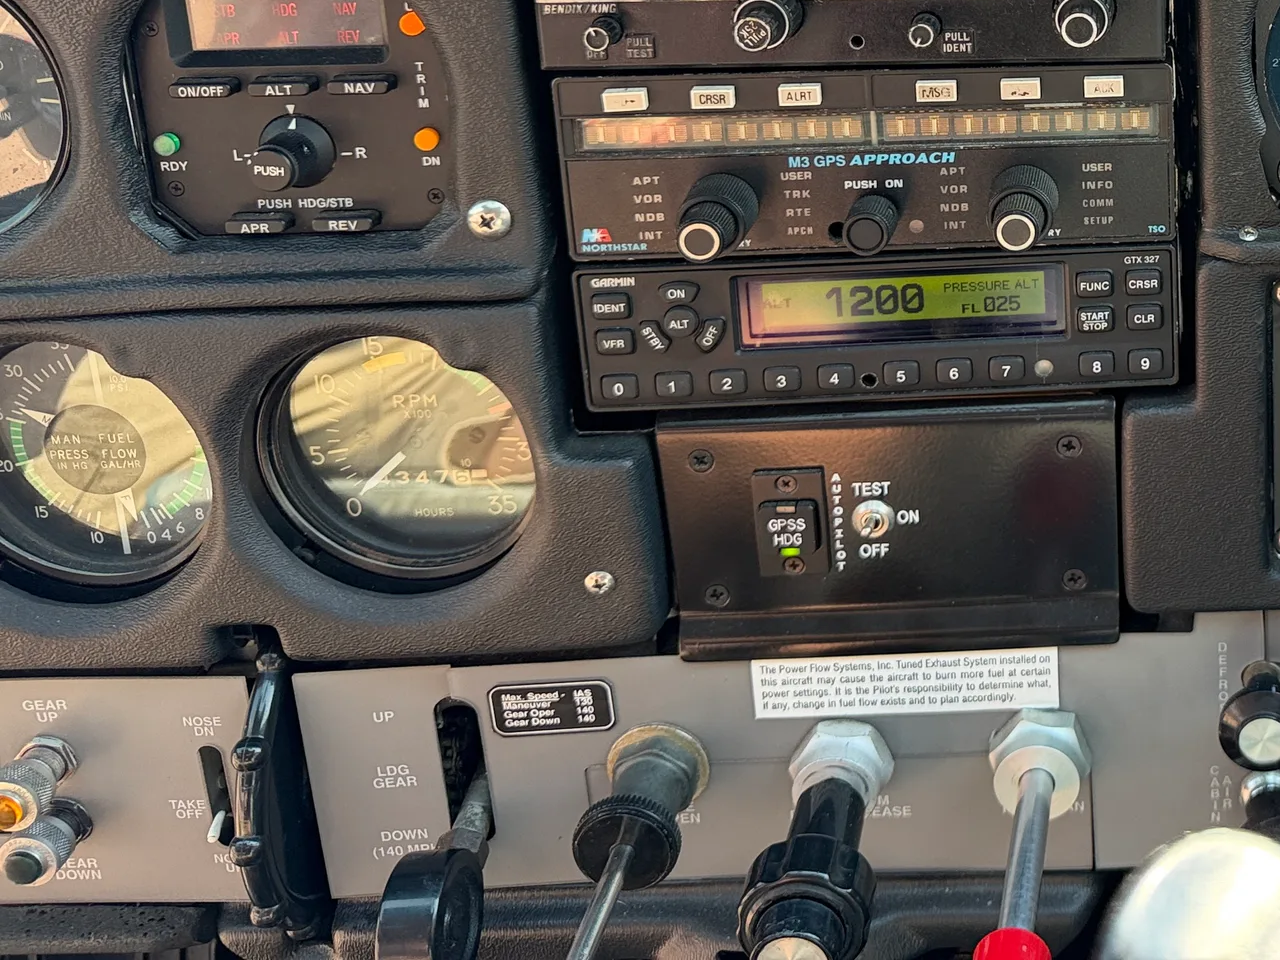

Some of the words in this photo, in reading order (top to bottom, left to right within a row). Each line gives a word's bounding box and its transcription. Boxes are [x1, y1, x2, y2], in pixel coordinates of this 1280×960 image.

[544, 4, 616, 14] BENDIX/KING
[943, 43, 972, 52] IDENT
[178, 87, 223, 97] ON/OFF
[787, 91, 812, 101] ALRT
[789, 157, 809, 167] M3
[814, 156, 845, 167] GPS
[850, 152, 956, 166] APPROACH
[160, 161, 187, 171] RDY
[781, 172, 811, 180] USER
[1082, 181, 1112, 189] INFO
[258, 199, 292, 208] PUSH
[299, 198, 353, 207] HDG/STB
[635, 213, 664, 221] NDB
[1084, 217, 1113, 225] SETUP
[240, 223, 269, 233] APR
[788, 226, 813, 235] APCH
[582, 243, 647, 252] NORTHSTAR
[1124, 256, 1142, 264] GTX
[590, 277, 635, 288] GARMIN
[944, 280, 1009, 292] PRESSURE
[1016, 279, 1038, 289] ALT
[1080, 281, 1109, 292] FUNC
[826, 284, 924, 317] 1200
[594, 304, 625, 313] IDENT
[1080, 312, 1109, 320] START
[669, 320, 688, 328] ALT
[1083, 322, 1107, 331] STOP
[603, 340, 624, 348] VFR
[393, 395, 438, 408] RPM
[51, 436, 81, 444] MAN
[99, 434, 134, 443] FUEL
[51, 450, 89, 459] PRESS
[102, 449, 137, 458] FLOW
[101, 460, 141, 468] GAL/HR
[852, 481, 890, 497] TEST
[415, 508, 454, 516] HOURS
[768, 518, 806, 533] GPSS
[774, 533, 802, 547] HDG
[859, 544, 889, 558] OFF
[760, 666, 776, 674] The
[779, 665, 806, 673] Power
[810, 664, 830, 672] Flow
[834, 662, 874, 673] Systems,
[878, 661, 893, 670] Inc.
[896, 659, 922, 669] Tuned
[926, 658, 960, 668] Exhaust
[964, 657, 996, 668] System
[1000, 655, 1036, 664] installed
[1039, 655, 1050, 663] on
[761, 678, 777, 686] this
[782, 677, 812, 685] aircraft
[870, 674, 883, 682] the
[888, 672, 918, 681] aircraft
[923, 672, 931, 680] to
[936, 671, 956, 679] burn
[988, 669, 1004, 677] fuel
[1008, 668, 1016, 676] at
[1021, 667, 1050, 675] certain
[762, 691, 789, 699] power
[793, 688, 831, 698] settings.
[845, 687, 852, 695] is
[856, 686, 869, 694] the
[873, 685, 899, 694] Pilot's
[904, 683, 962, 694] responsibility
[979, 681, 1023, 689] determine
[1027, 679, 1051, 688] what,
[22, 700, 67, 710] GEAR
[502, 701, 551, 710] Maneuver
[772, 702, 790, 711] any,
[793, 700, 825, 709] change
[859, 698, 877, 706] flow
[881, 698, 906, 706] exists
[909, 697, 925, 705] and
[929, 696, 937, 704] to
[941, 696, 959, 705] plan
[962, 692, 1016, 703] accordingly.
[183, 717, 221, 726] NOSE
[377, 765, 409, 777] LDG
[169, 800, 205, 809] TAKE
[381, 829, 428, 841] DOWN
[56, 870, 101, 880] DOWN
